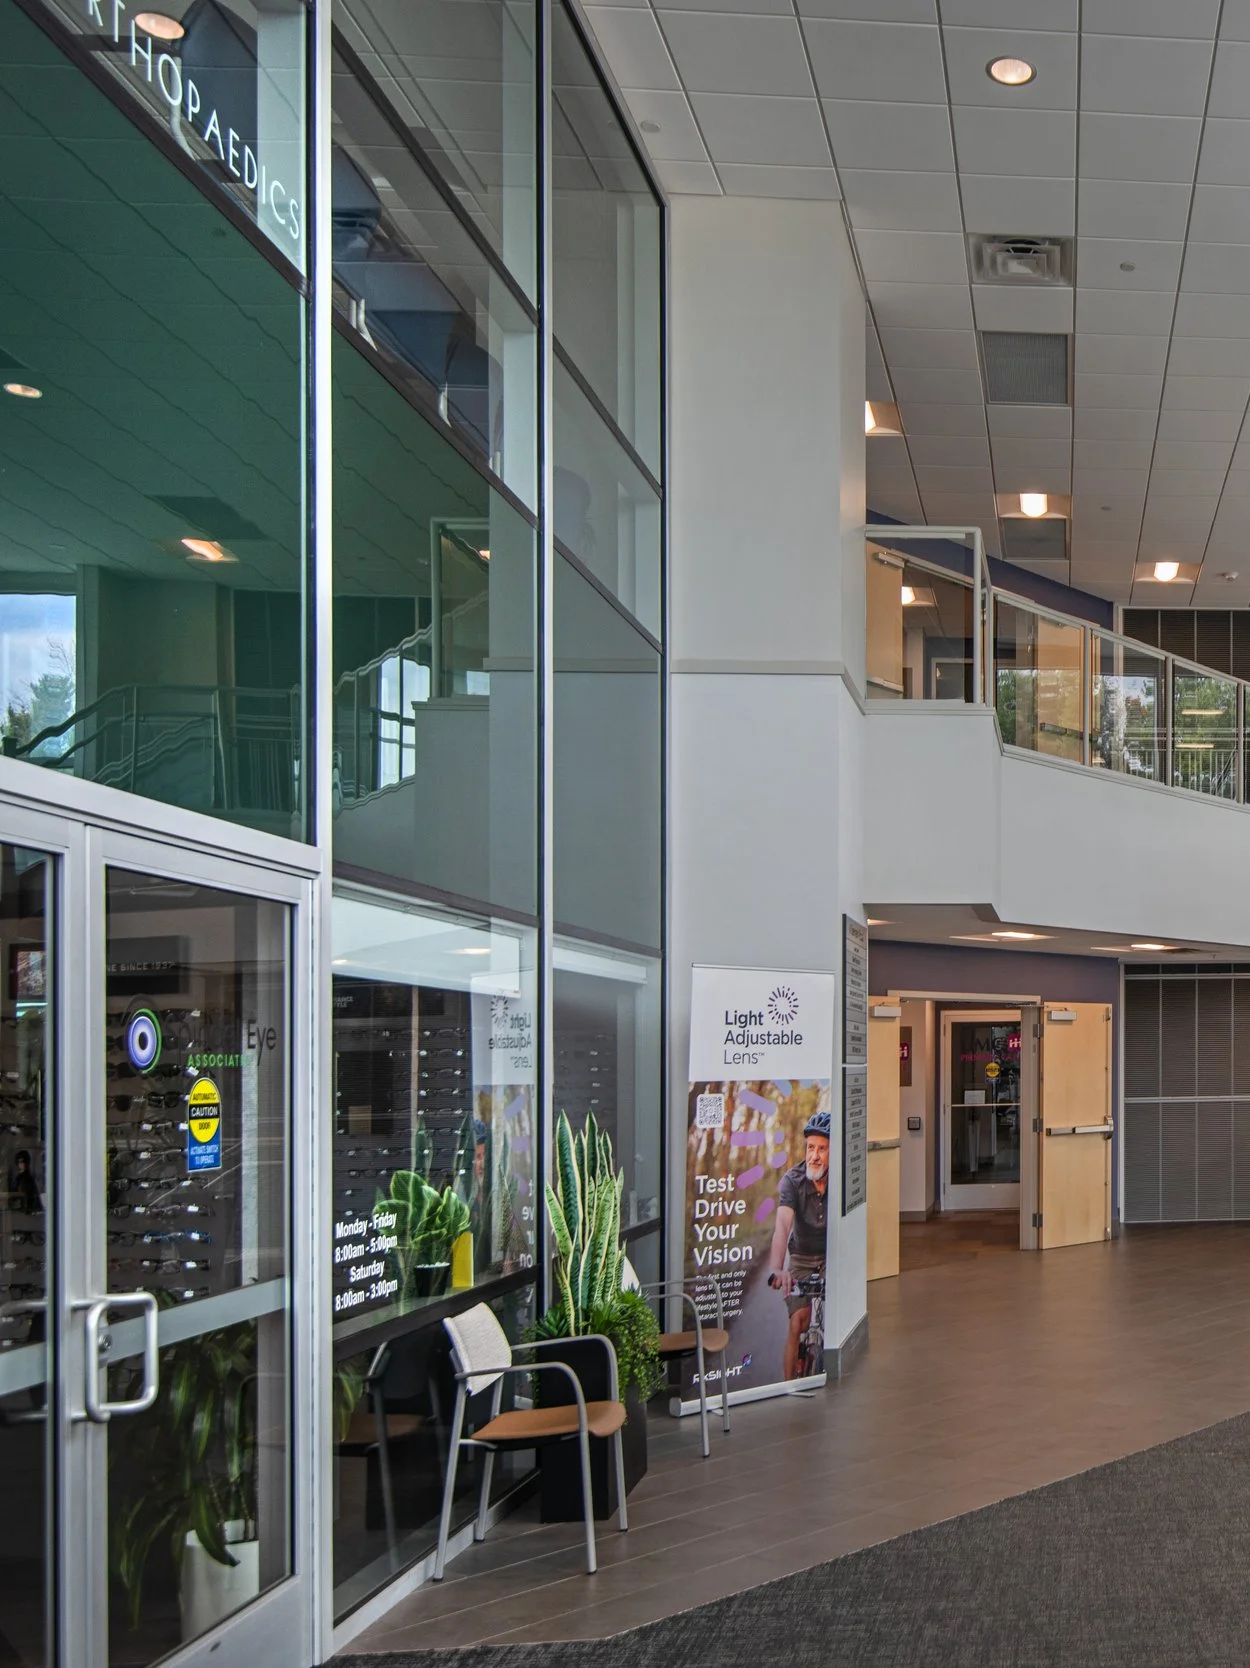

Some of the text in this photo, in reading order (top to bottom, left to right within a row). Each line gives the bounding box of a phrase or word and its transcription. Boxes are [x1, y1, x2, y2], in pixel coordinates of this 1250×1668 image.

[725, 1010, 764, 1029] Light
[247, 1019, 277, 1066] Eye
[724, 1030, 803, 1048] Adjustable
[193, 1093, 216, 1101] AUTOMATIC
[191, 1106, 218, 1117] CAUTION
[198, 1122, 211, 1130] DOOR
[695, 1173, 735, 1195] Test
[695, 1197, 747, 1219] Drive
[335, 1218, 368, 1239] Monday
[372, 1211, 397, 1230] Friday
[694, 1223, 739, 1242] Your
[335, 1243, 365, 1263] 8:00am
[370, 1234, 397, 1255] 5:00pm
[693, 1243, 753, 1267] Vision
[350, 1260, 385, 1283] Saturday
[721, 1271, 733, 1279] and
[335, 1290, 365, 1312] 8:00am
[370, 1279, 398, 1300] 3:00pm
[695, 1292, 718, 1302] adjuste
[729, 1290, 743, 1299] your
